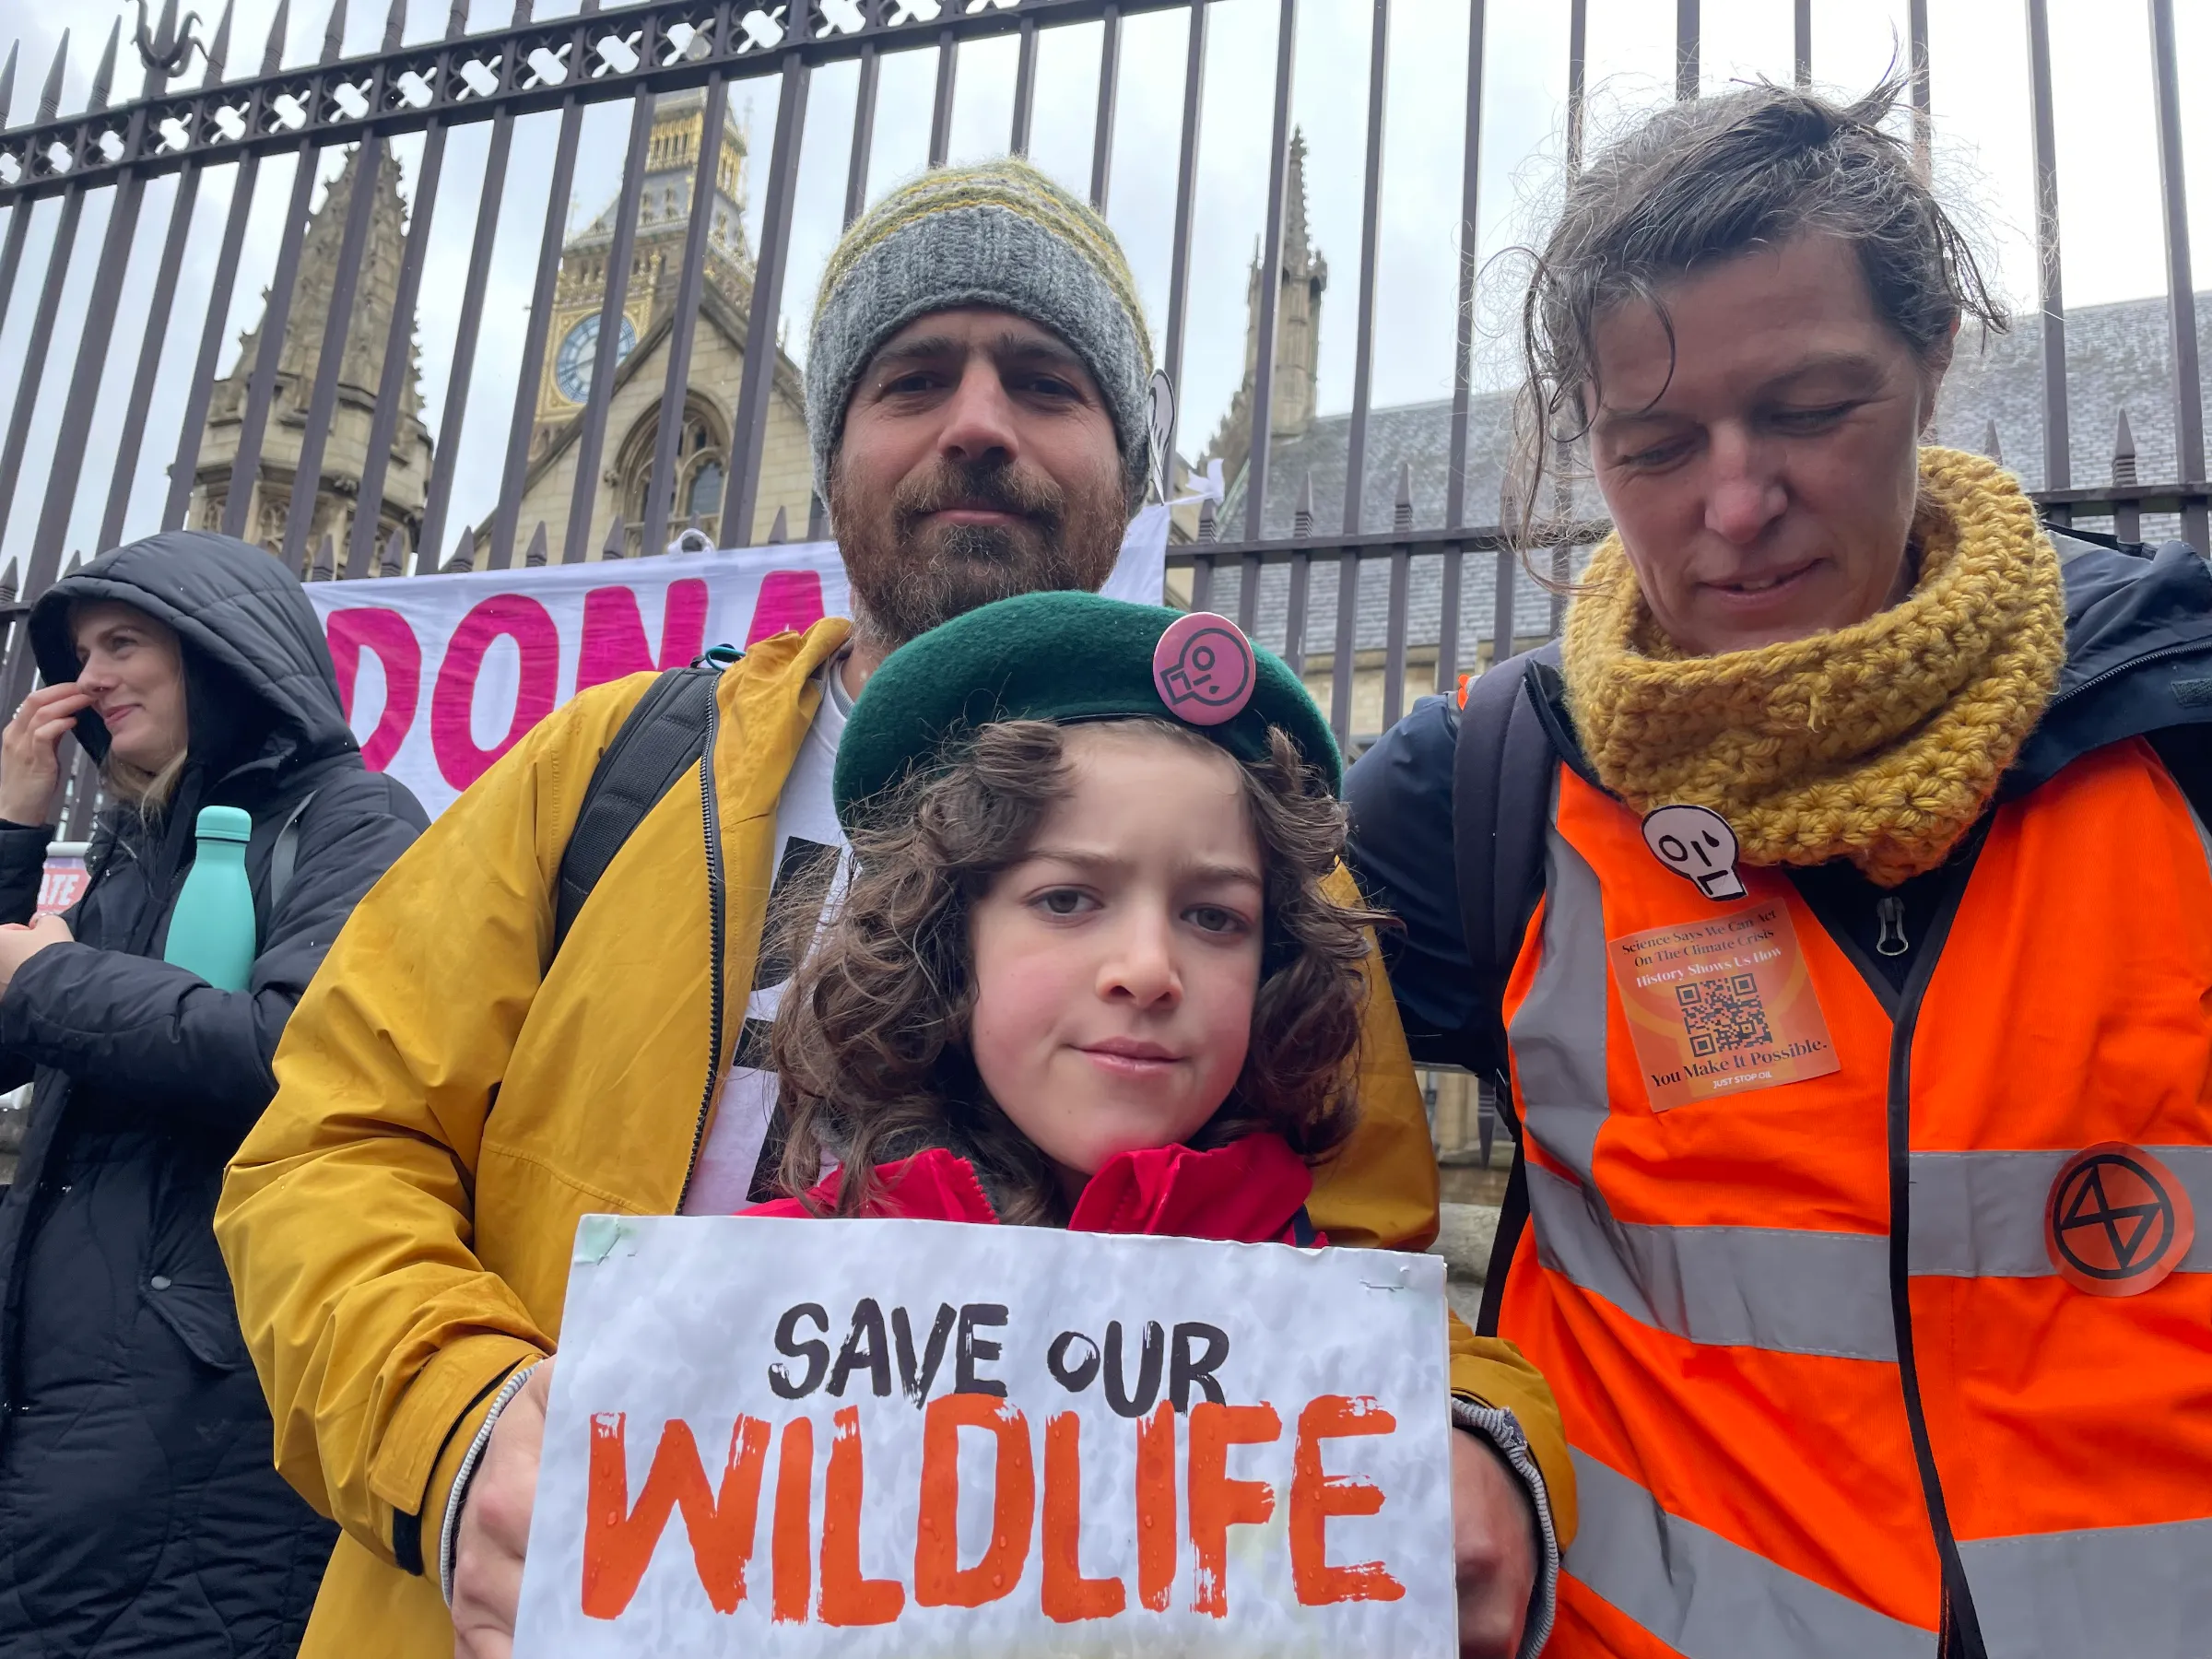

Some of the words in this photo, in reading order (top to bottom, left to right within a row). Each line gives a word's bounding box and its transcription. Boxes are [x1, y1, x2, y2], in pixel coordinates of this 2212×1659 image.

[1622, 935, 1670, 955] Science
[1674, 929, 1703, 944] Says
[1704, 925, 1726, 936] We
[1728, 919, 1754, 932] Can
[1757, 909, 1777, 923] Act
[1634, 955, 1653, 968] On
[1655, 948, 1681, 961] The
[1683, 940, 1735, 957] Climate
[1737, 929, 1774, 947] Crisis
[1636, 968, 1684, 989] History
[1688, 961, 1732, 976] Shows
[1734, 955, 1751, 968] Us
[1753, 947, 1782, 963] How
[1651, 1071, 1682, 1088] You
[1683, 1059, 1730, 1080] Make
[1733, 1054, 1747, 1068] It
[1749, 1039, 1828, 1066] Possible.
[1712, 1077, 1734, 1089] JUST
[1734, 1073, 1759, 1085] STOP
[1759, 1070, 1773, 1080] OIL
[768, 1298, 1009, 1408] SAVE
[1047, 1319, 1230, 1418] OUR
[581, 1393, 1407, 1627] WILDLIFE
